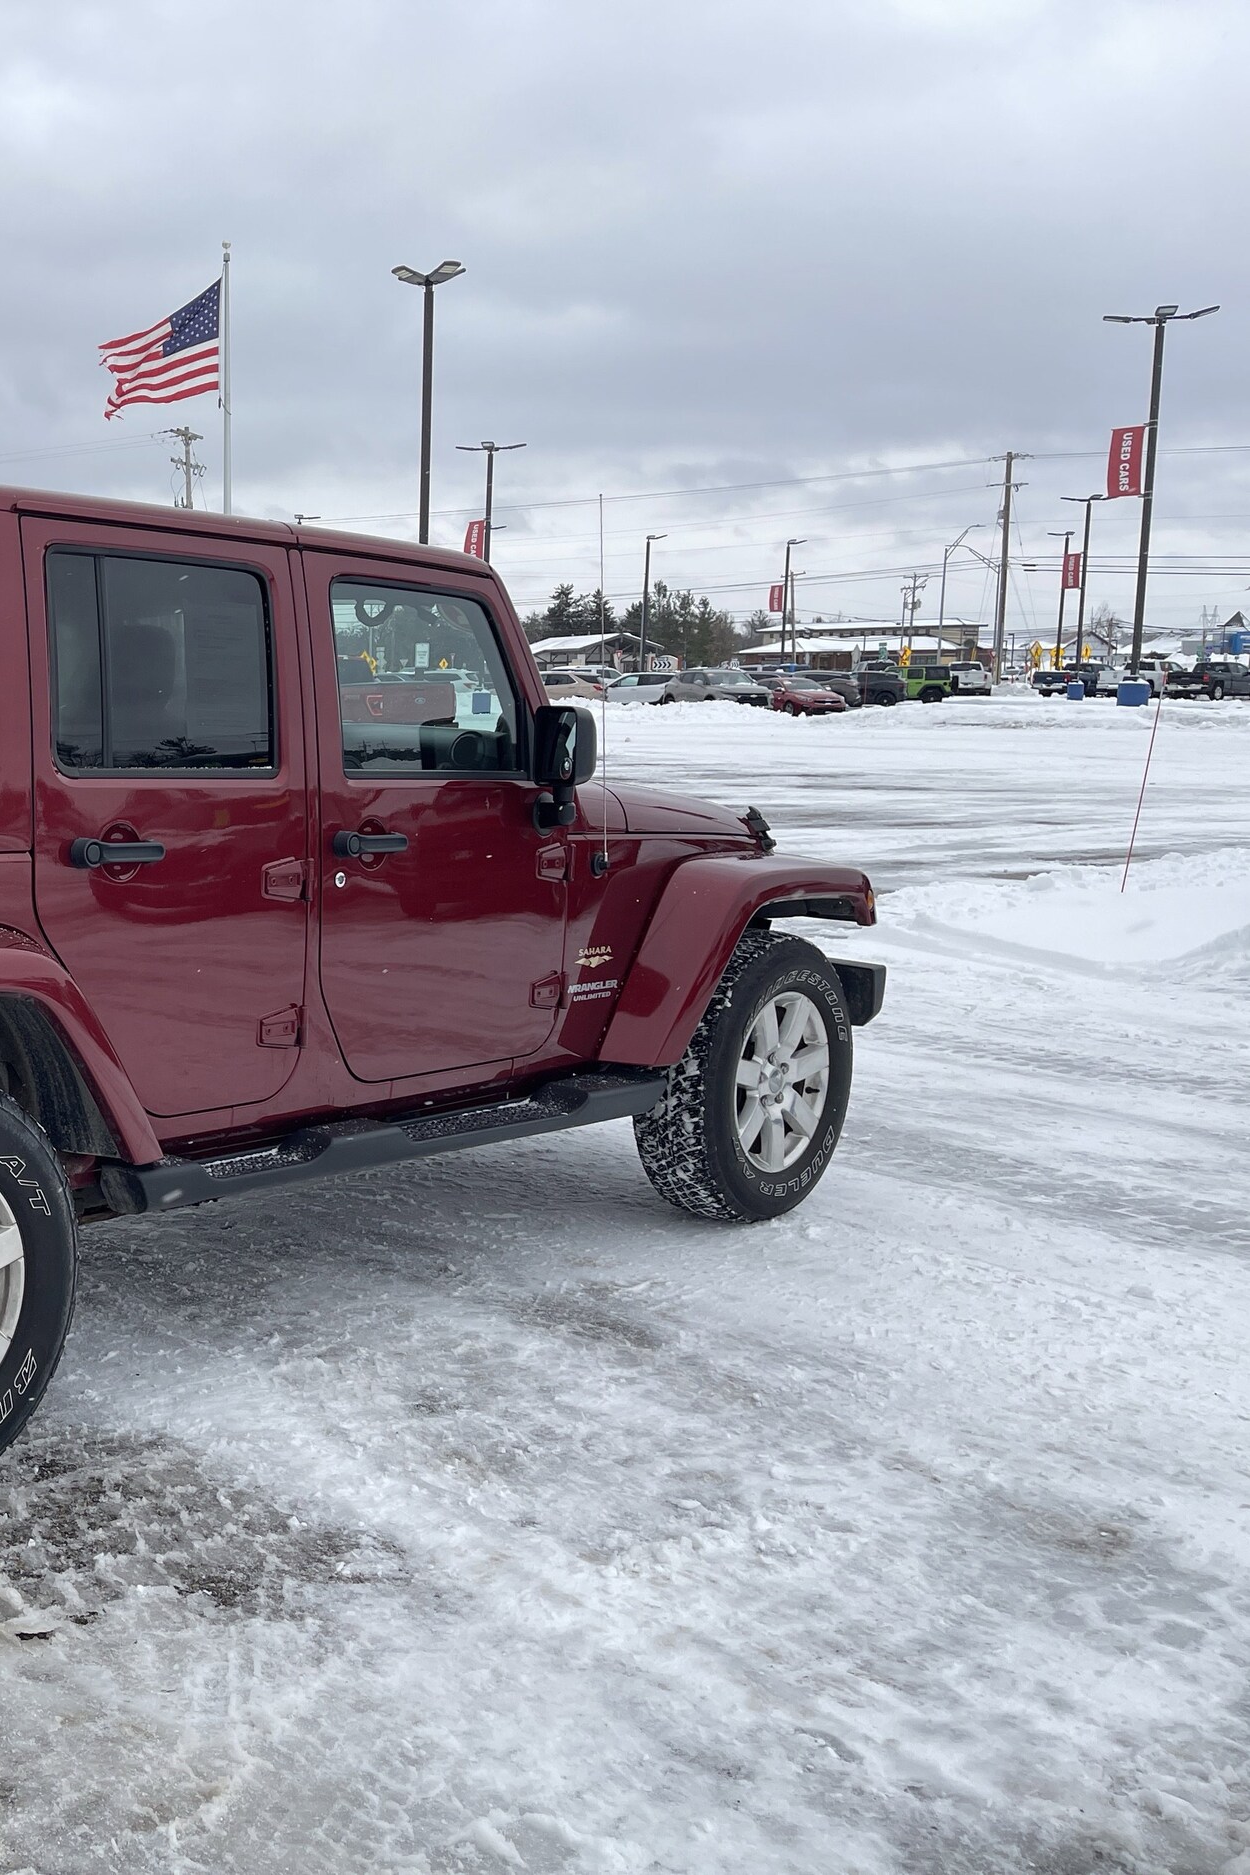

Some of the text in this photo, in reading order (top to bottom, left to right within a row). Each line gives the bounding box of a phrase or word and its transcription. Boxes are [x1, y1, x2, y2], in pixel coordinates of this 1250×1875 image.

[1119, 432, 1133, 491] USED CARS
[471, 524, 479, 543] USED
[578, 945, 612, 957] SAHARA
[567, 979, 618, 994] WRANGLER
[573, 991, 611, 1002] UNLIMITED
[743, 969, 848, 1042] BRIDGESTONE
[759, 1124, 835, 1197] DUELER
